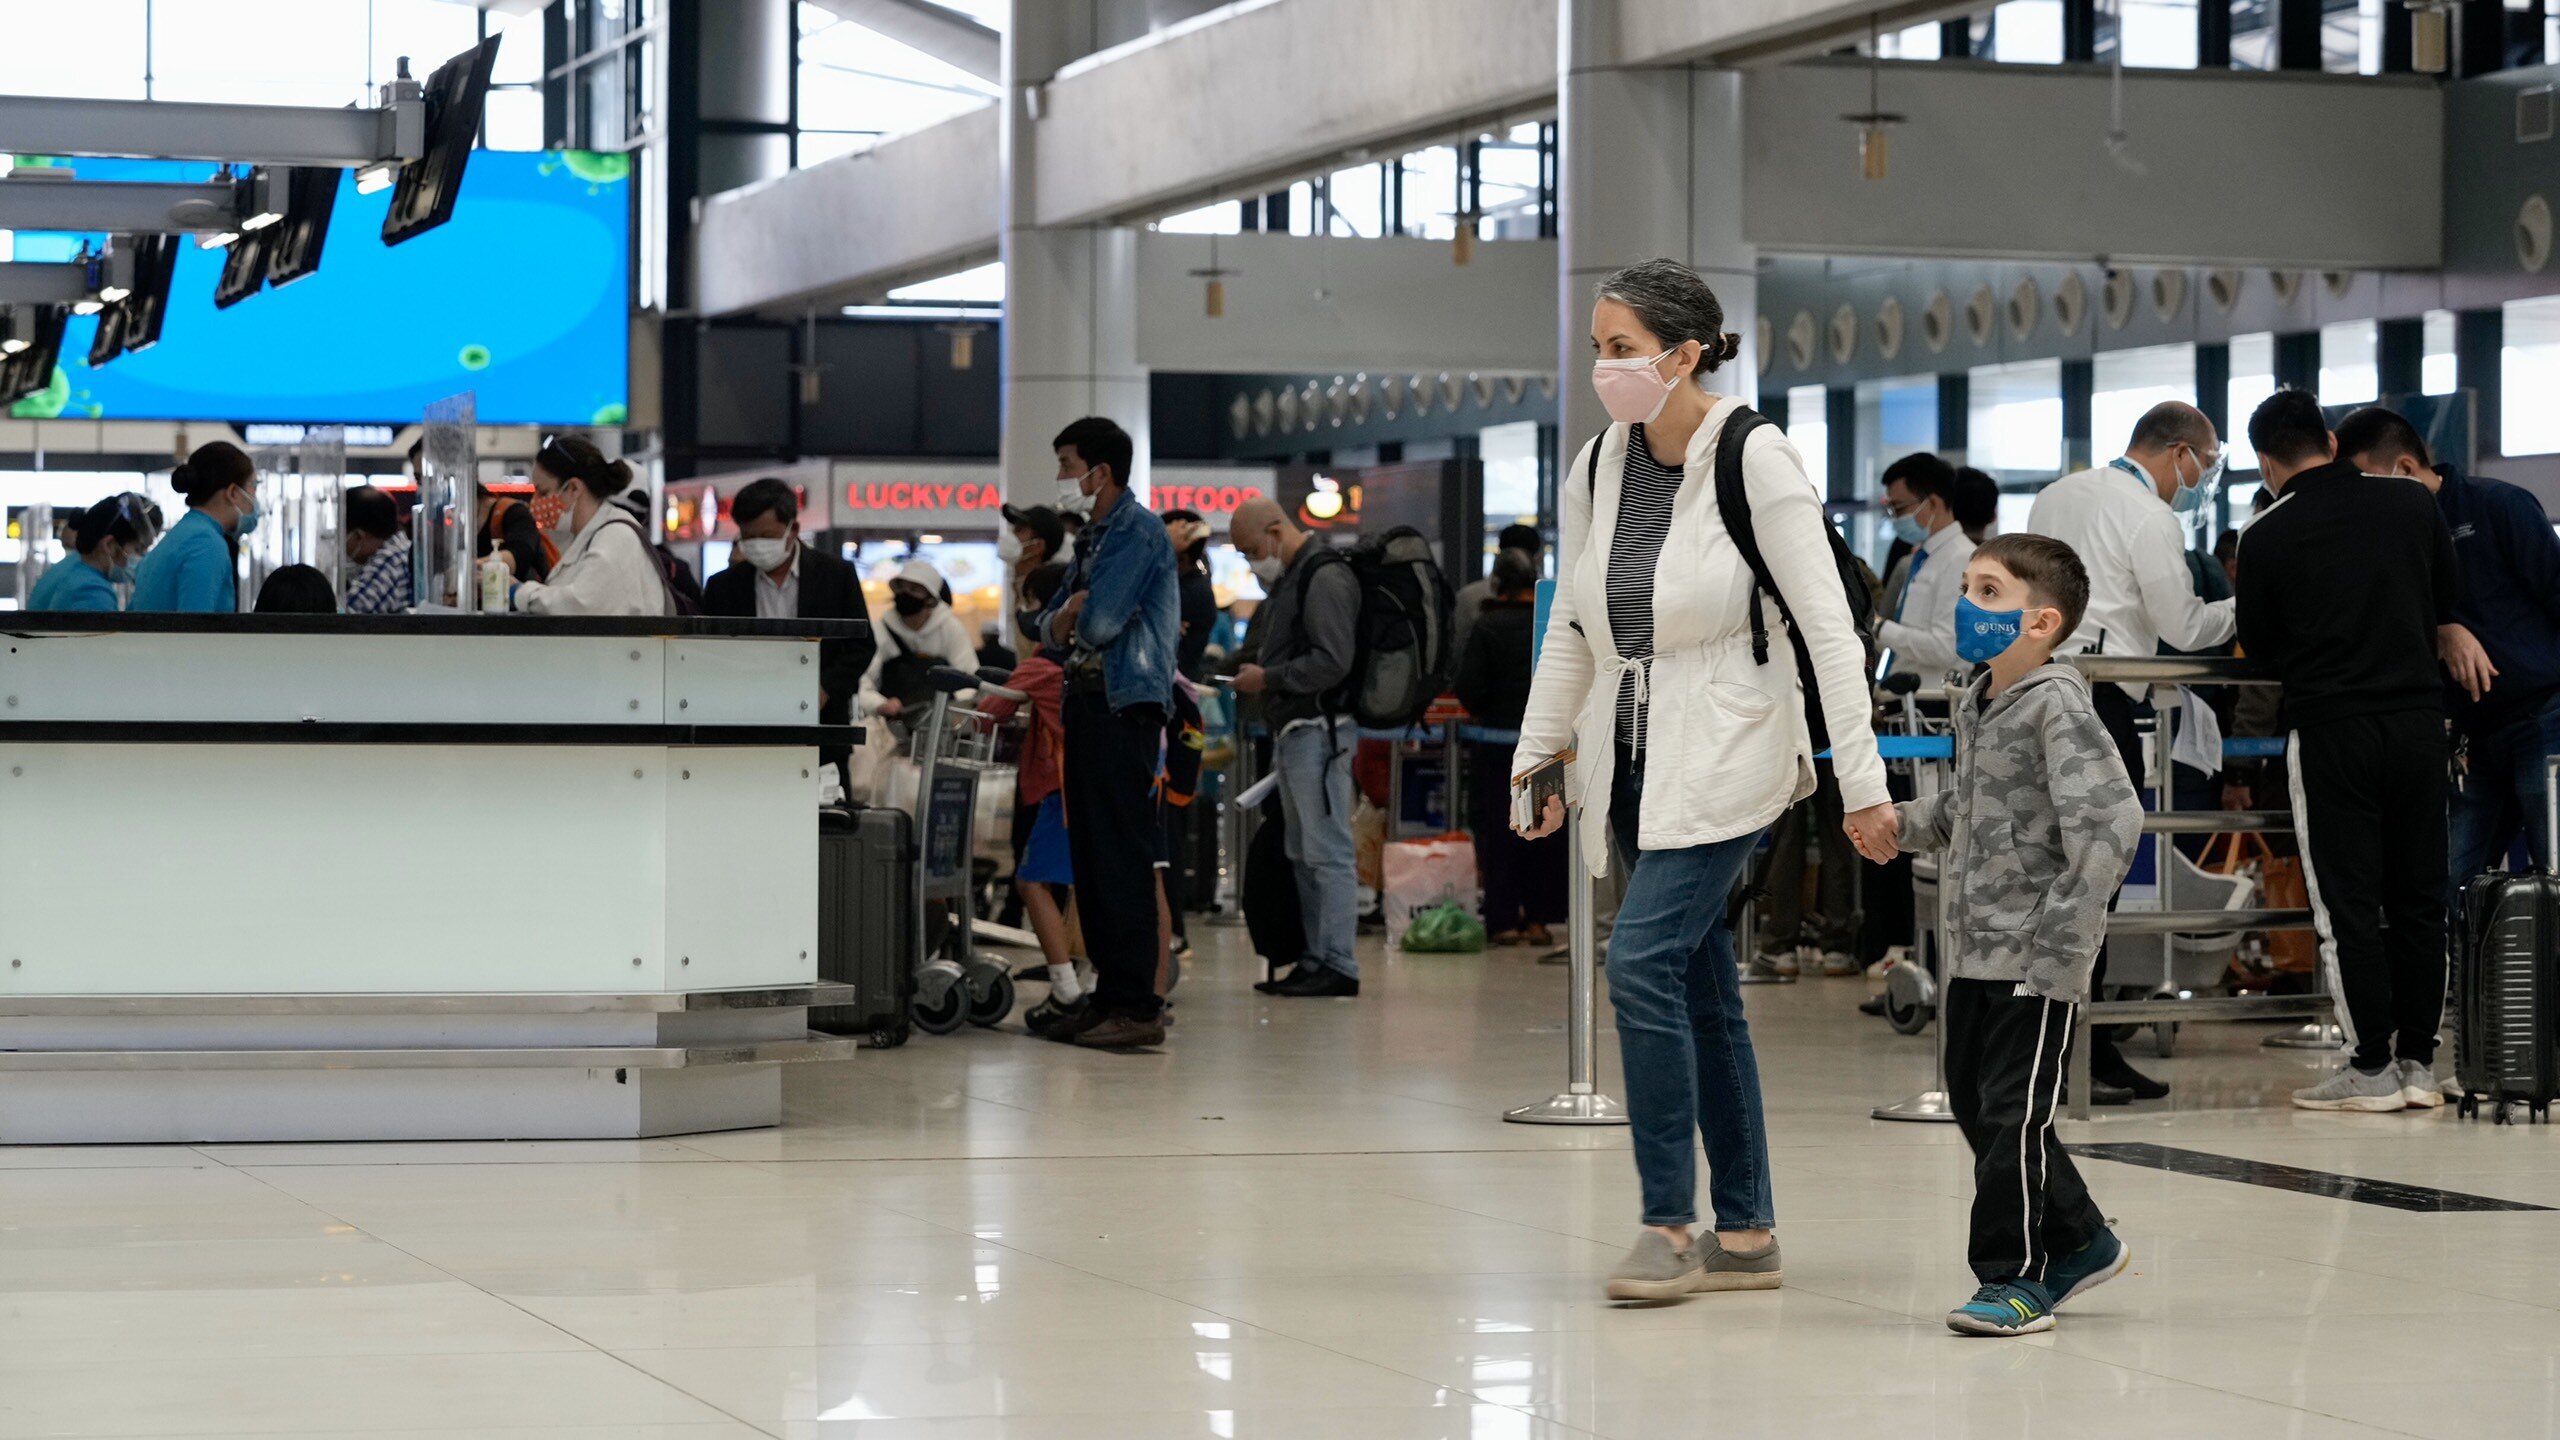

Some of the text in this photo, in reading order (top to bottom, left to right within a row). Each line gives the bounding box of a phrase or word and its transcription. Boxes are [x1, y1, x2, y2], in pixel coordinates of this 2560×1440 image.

[848, 483, 953, 510] LUCKY
[1990, 623, 2016, 635] UNIS
[2013, 983, 2038, 996] NIK
